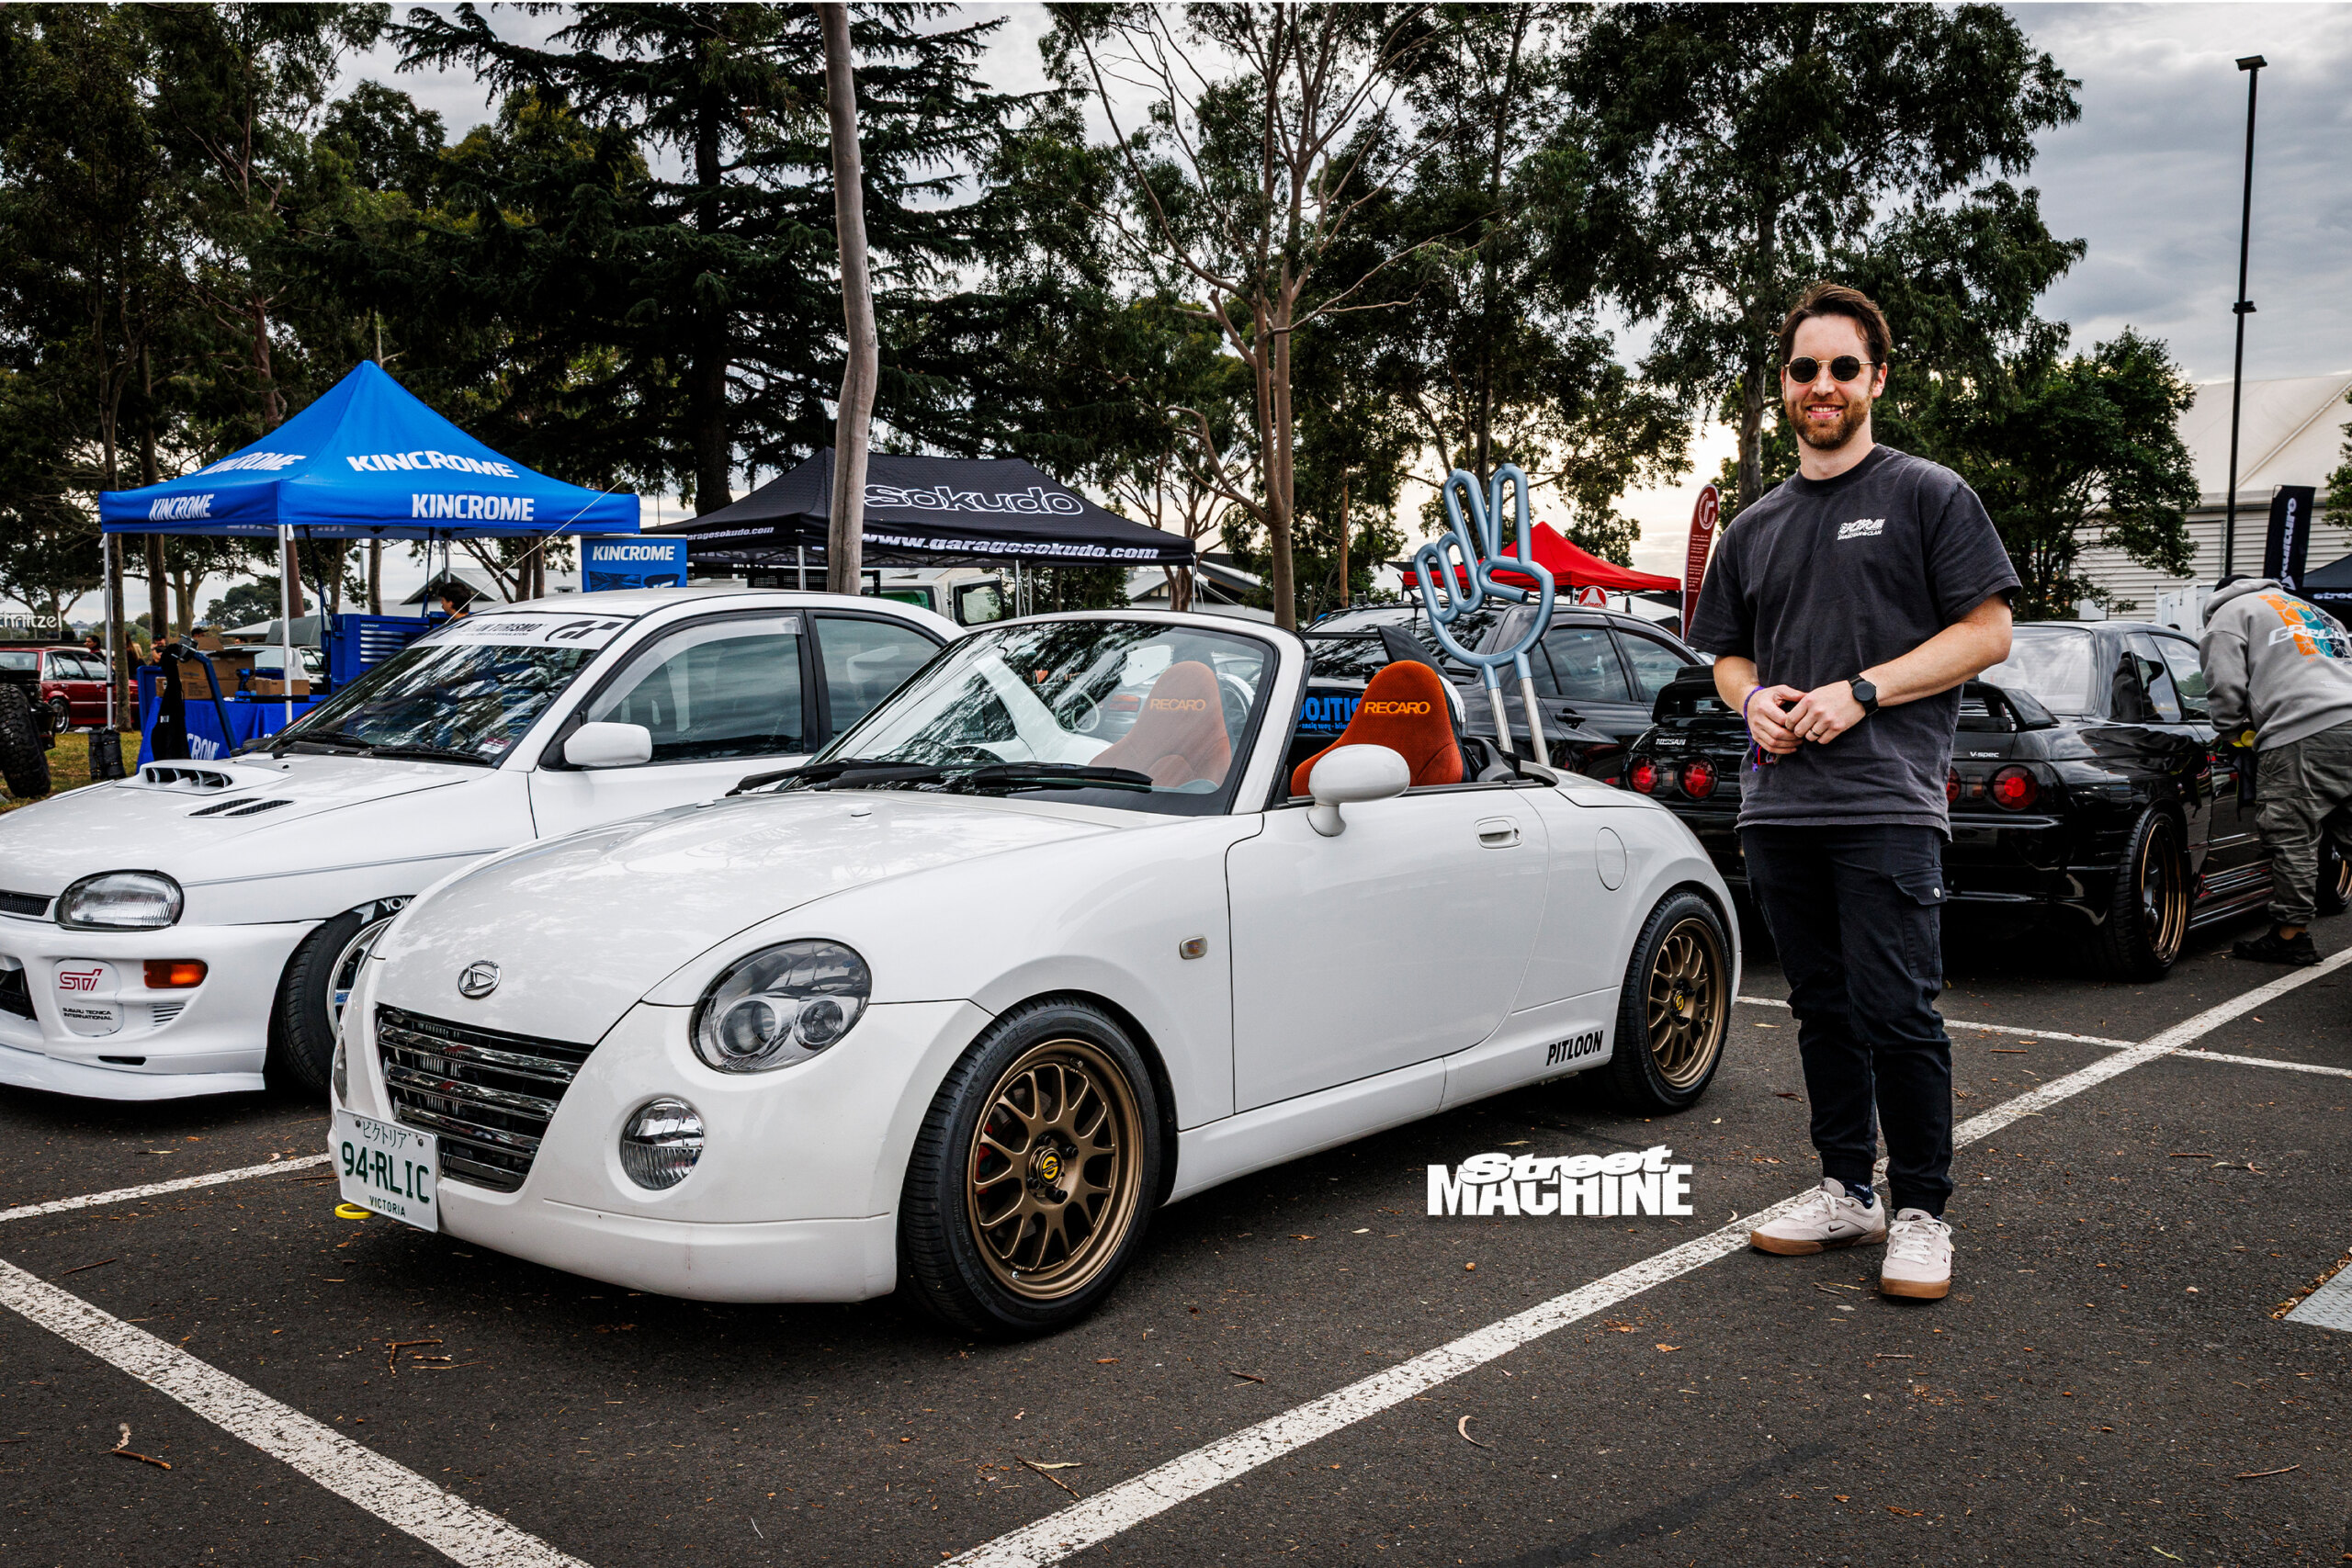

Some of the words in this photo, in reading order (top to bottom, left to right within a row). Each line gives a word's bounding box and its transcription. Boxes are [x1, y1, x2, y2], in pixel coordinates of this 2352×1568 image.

[346, 450, 519, 479] KINCROME
[148, 493, 214, 522] KINCROME
[412, 493, 535, 522] KINCROME
[686, 526, 775, 541] aragesokudo.com
[593, 546, 675, 561] KINCROME
[0, 611, 62, 629] hnitzel
[1150, 698, 1206, 711] RECARO
[1363, 701, 1430, 715] RECARO
[63, 1012, 113, 1021] INTERNATIONAL
[1545, 1030, 1604, 1066] PITLOON
[362, 1121, 407, 1149] ビクトリア
[342, 1141, 430, 1203] 94-RLIC
[368, 1195, 406, 1217] VICTORIA
